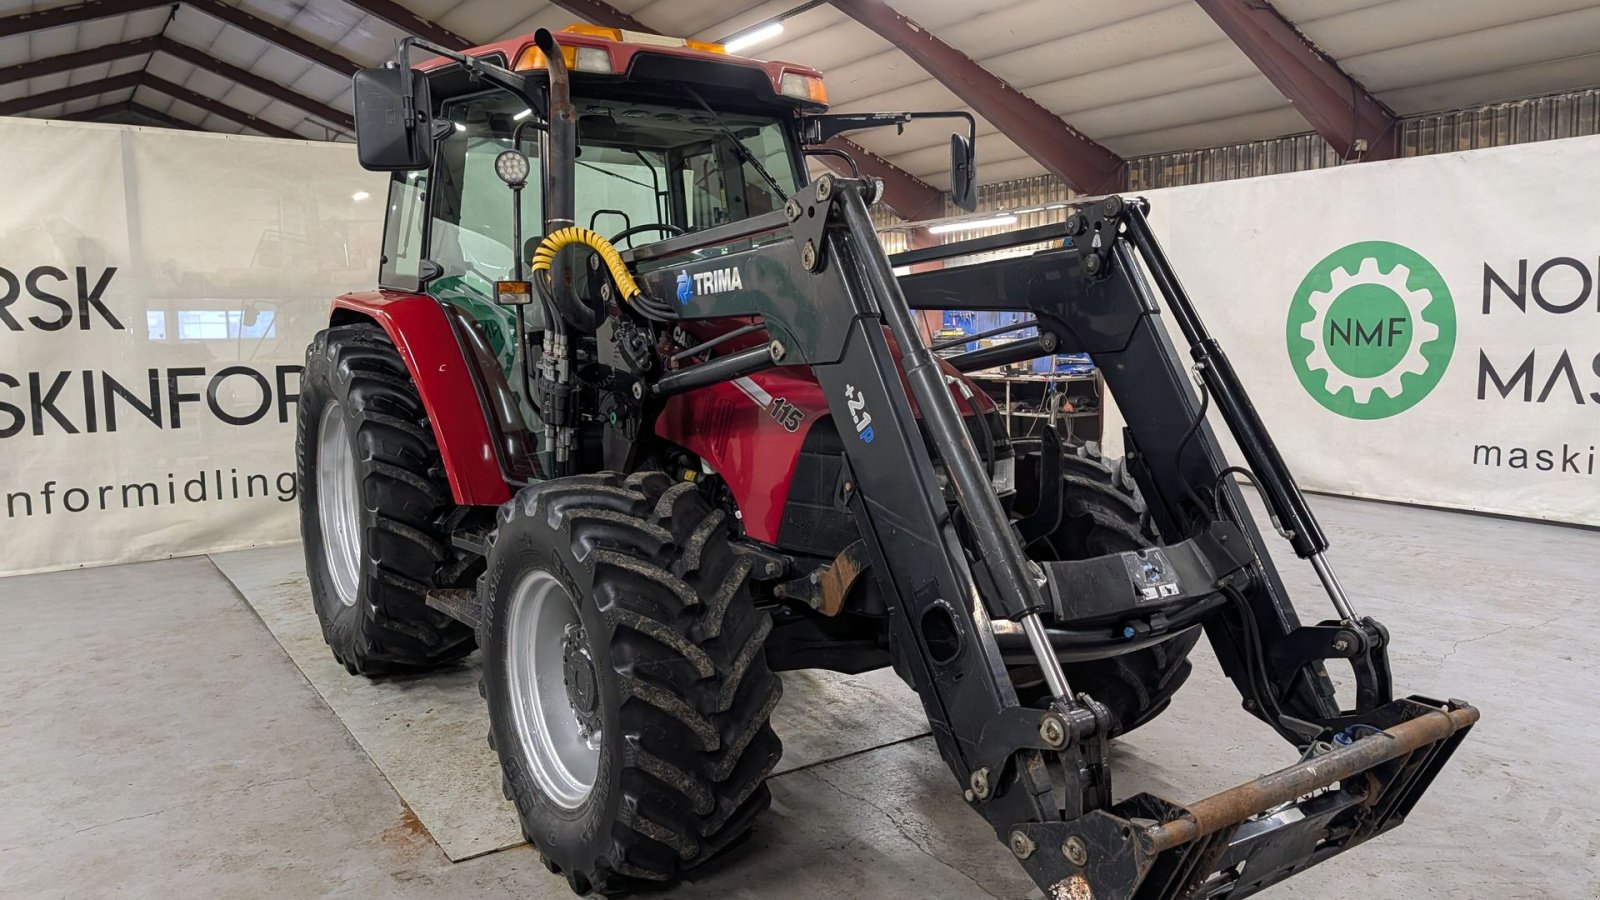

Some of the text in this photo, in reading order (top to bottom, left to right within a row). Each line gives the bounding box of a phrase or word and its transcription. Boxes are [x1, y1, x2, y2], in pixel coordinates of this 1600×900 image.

[693, 266, 743, 296] TRIMA
[1482, 255, 1600, 314] NO
[673, 326, 703, 349] CAS
[1329, 317, 1406, 347] NMF
[1476, 347, 1600, 406] MA
[769, 397, 805, 433] 115
[1473, 443, 1595, 475] maski
